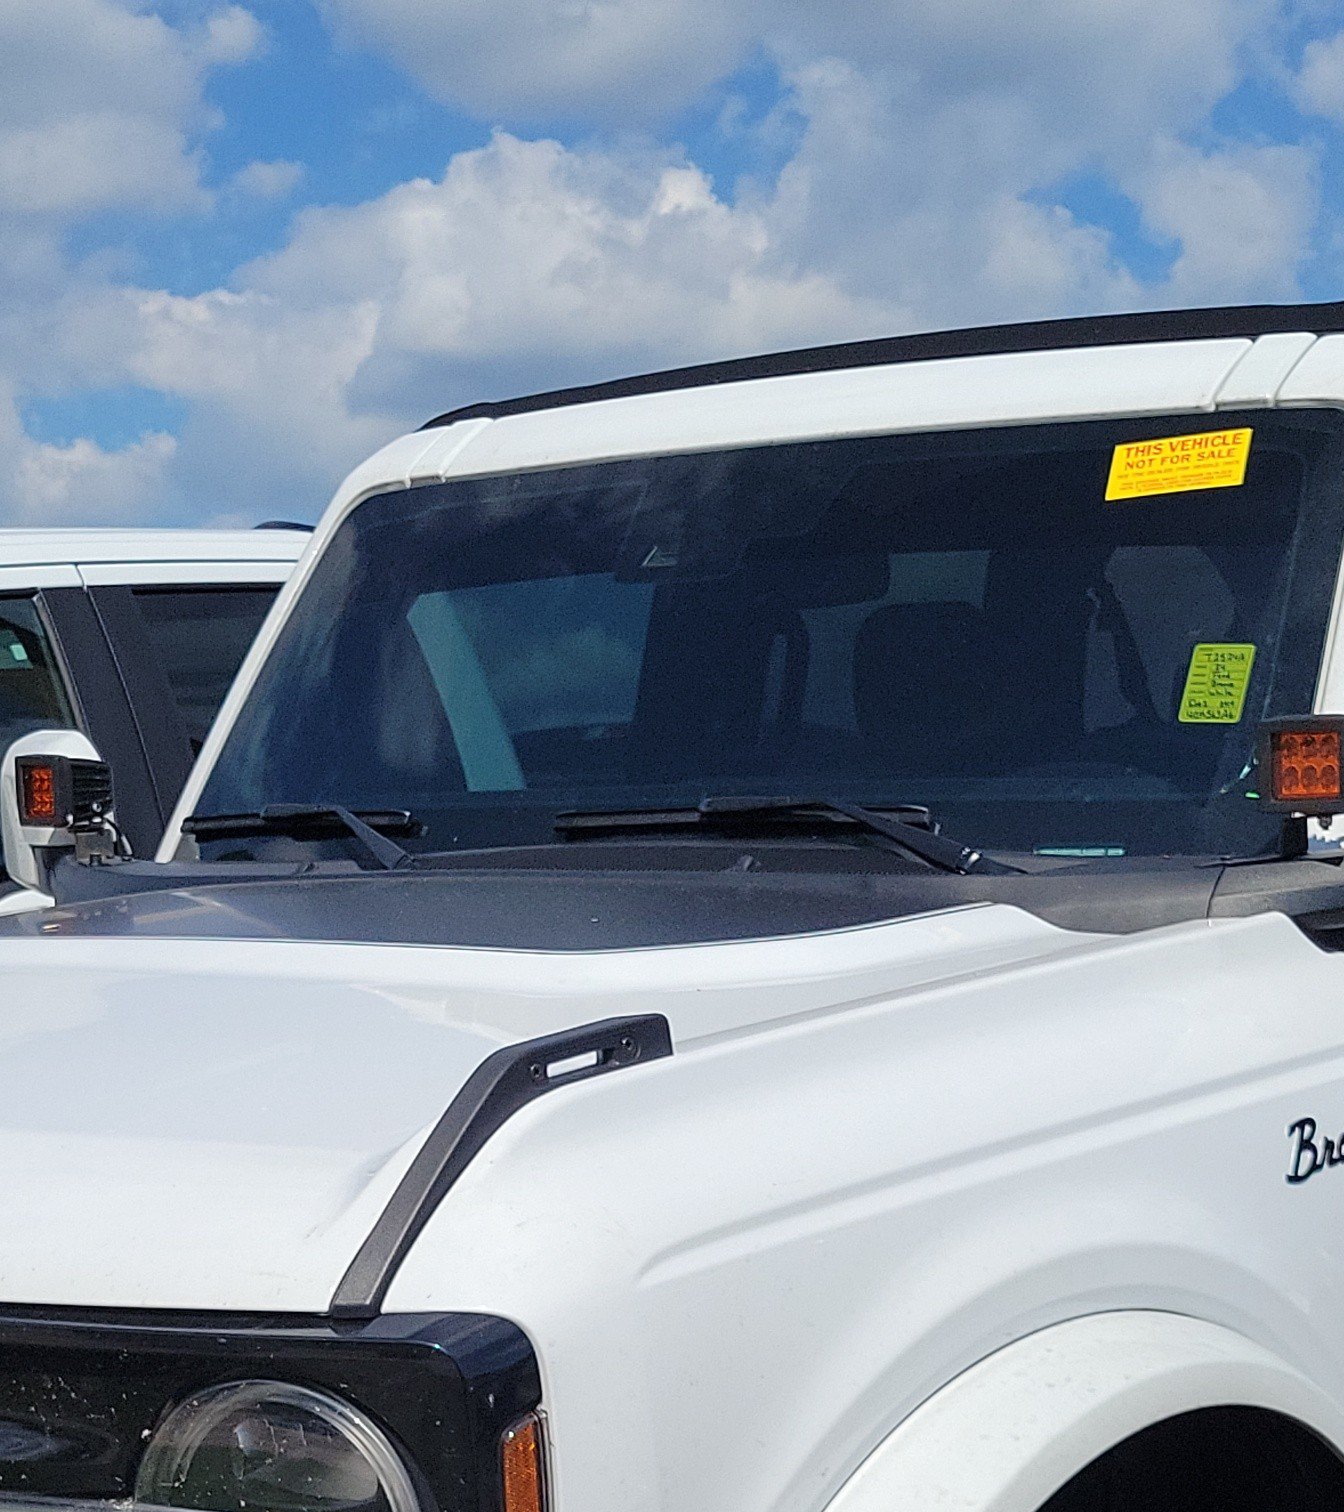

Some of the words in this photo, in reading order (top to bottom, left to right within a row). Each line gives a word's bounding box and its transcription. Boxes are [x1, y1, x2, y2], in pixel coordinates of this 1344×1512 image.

[1124, 443, 1163, 459] THIS
[1168, 432, 1244, 453] VEHICLE
[1124, 457, 1156, 471] NOT
[1160, 453, 1191, 466] FOR
[1197, 448, 1236, 462] SALE
